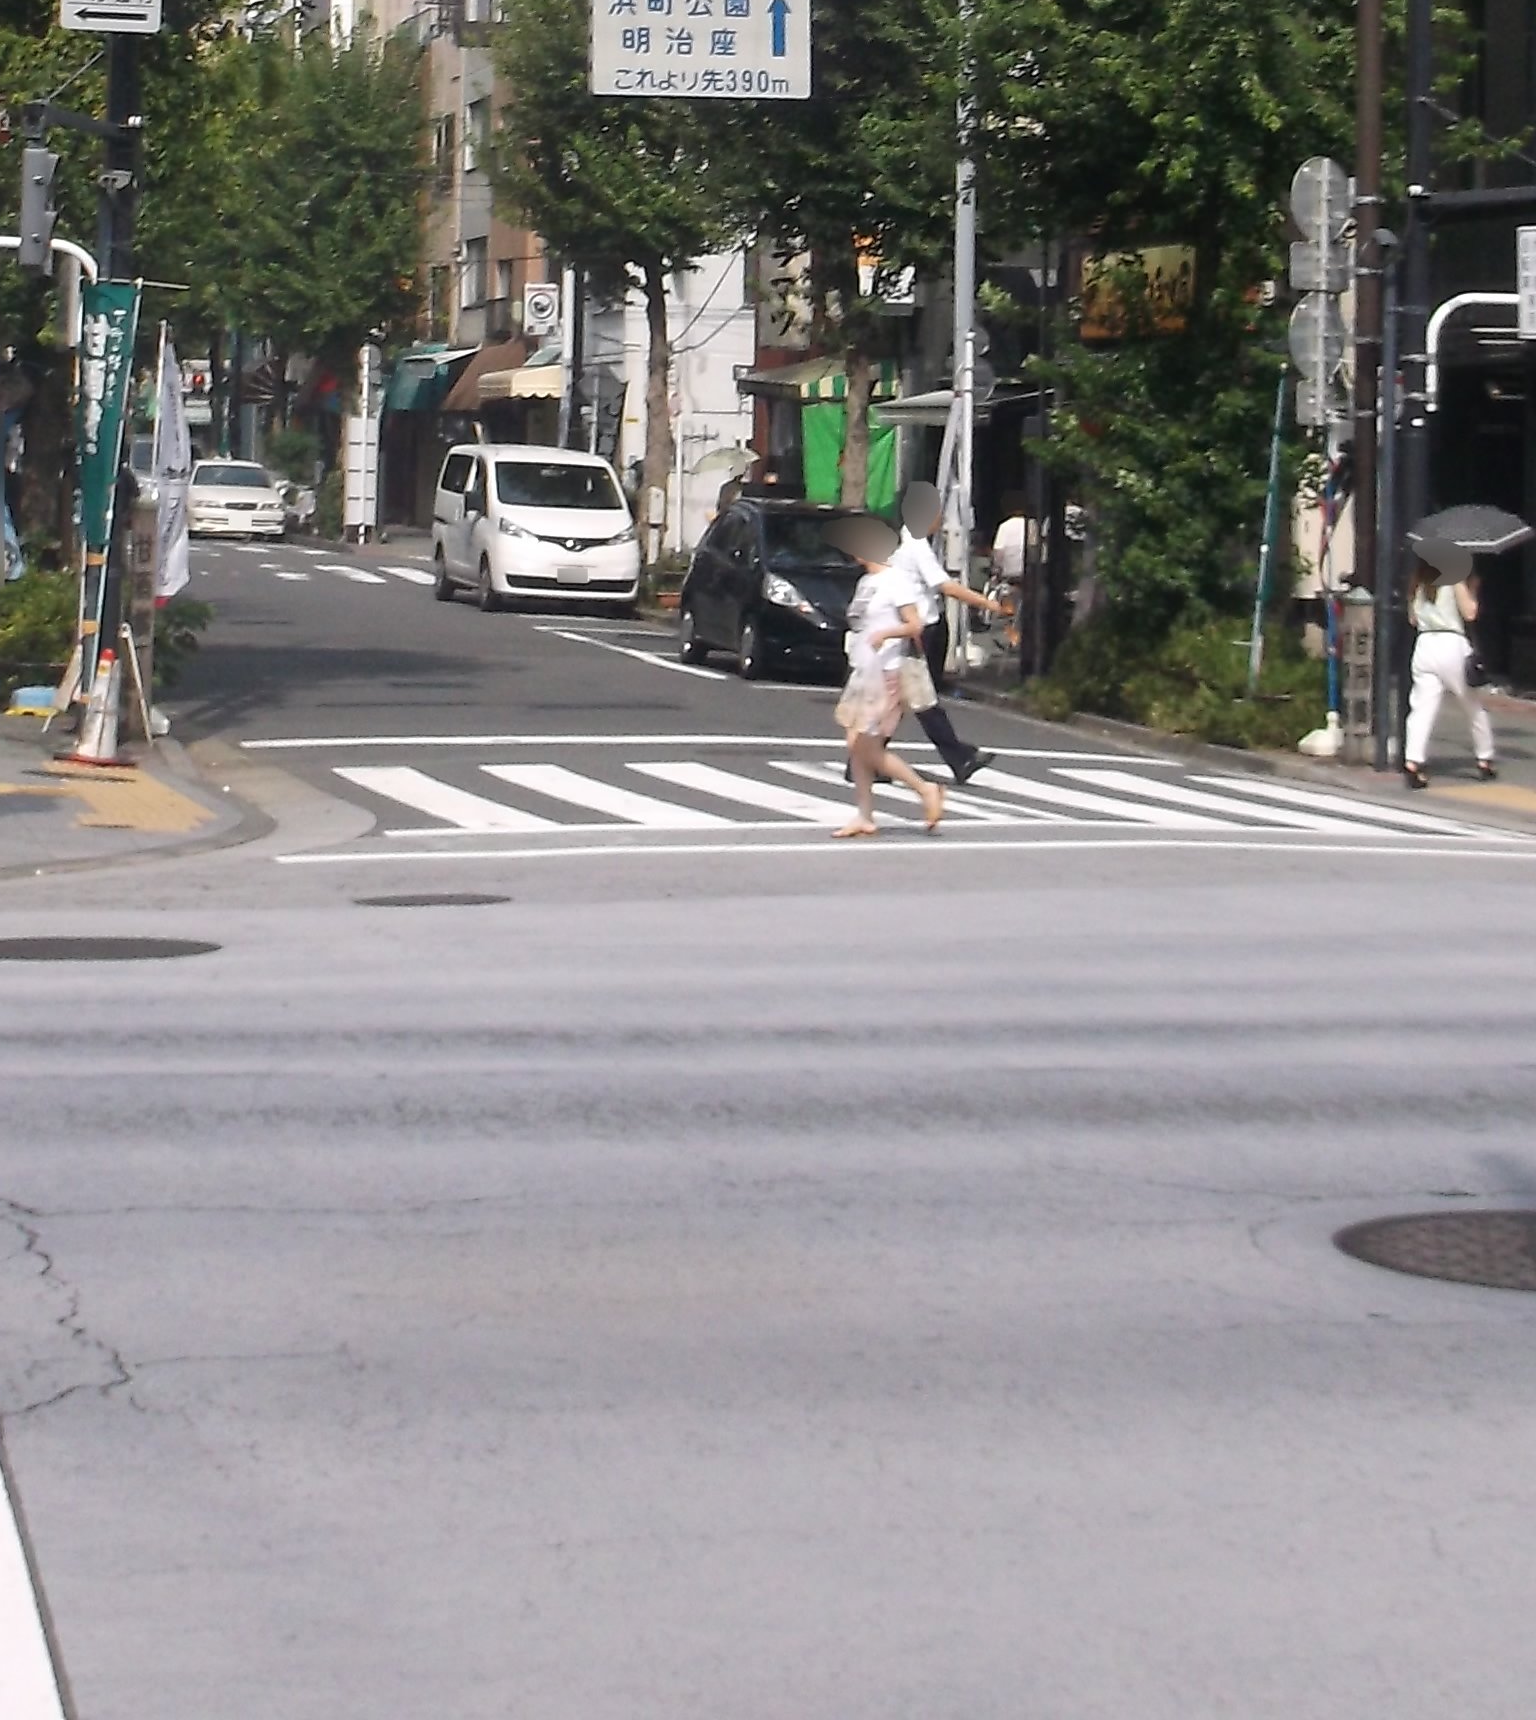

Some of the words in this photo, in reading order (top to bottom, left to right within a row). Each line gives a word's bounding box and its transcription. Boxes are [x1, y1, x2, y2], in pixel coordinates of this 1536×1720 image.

[621, 27, 738, 57] 明治座
[614, 68, 790, 94] これより先390m
